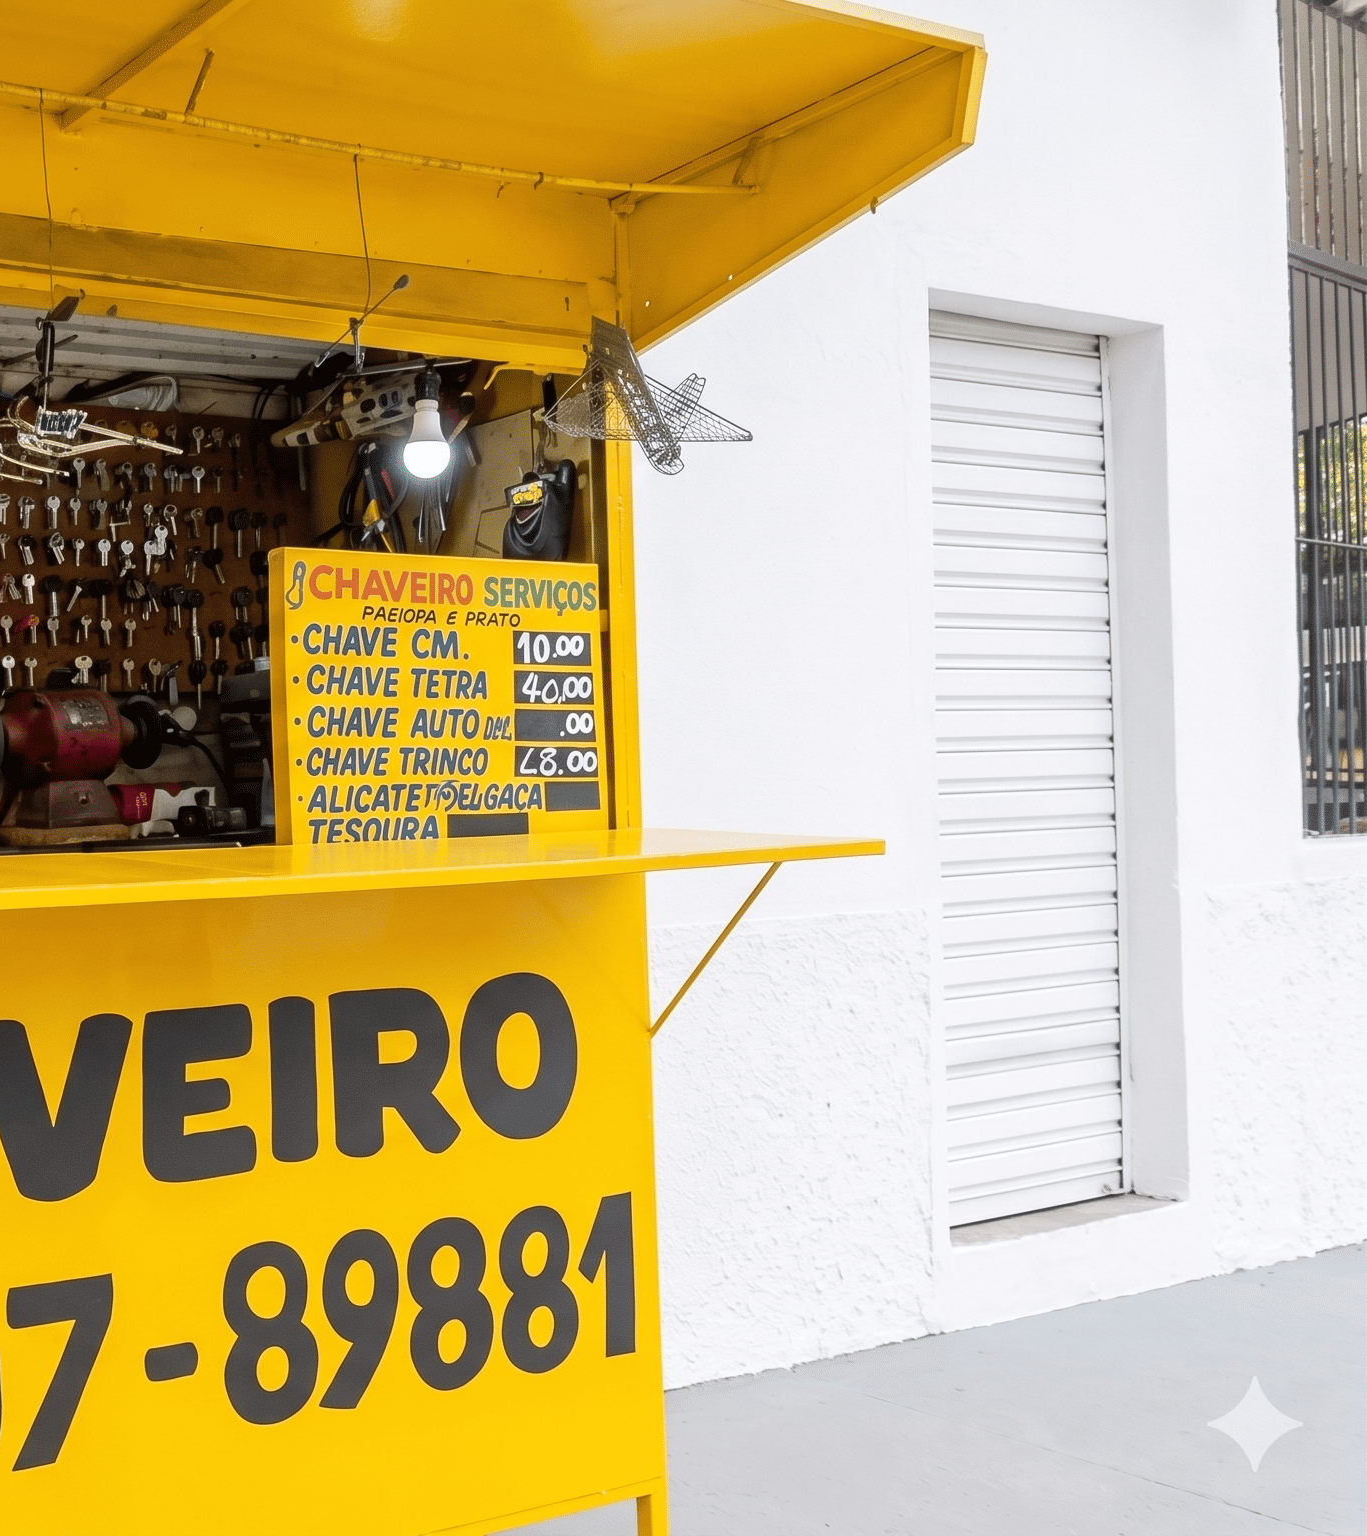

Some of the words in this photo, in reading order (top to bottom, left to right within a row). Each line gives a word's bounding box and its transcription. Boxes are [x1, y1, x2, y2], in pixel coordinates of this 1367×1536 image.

[308, 564, 473, 606] CHAVEIRO
[483, 576, 597, 617] SERVIÇOS
[446, 611, 458, 625] E
[465, 611, 521, 628] PRATO
[302, 623, 398, 659] CHAVE
[411, 628, 469, 660] CM.
[517, 631, 585, 664] 10.00
[306, 663, 400, 698] CHAVE
[410, 667, 488, 700] TETRA
[307, 705, 400, 739] CHAVE
[410, 708, 480, 740] AUTO
[306, 746, 390, 777] CHAVE
[399, 746, 489, 777] TRINCO
[308, 814, 439, 845] TESOURA
